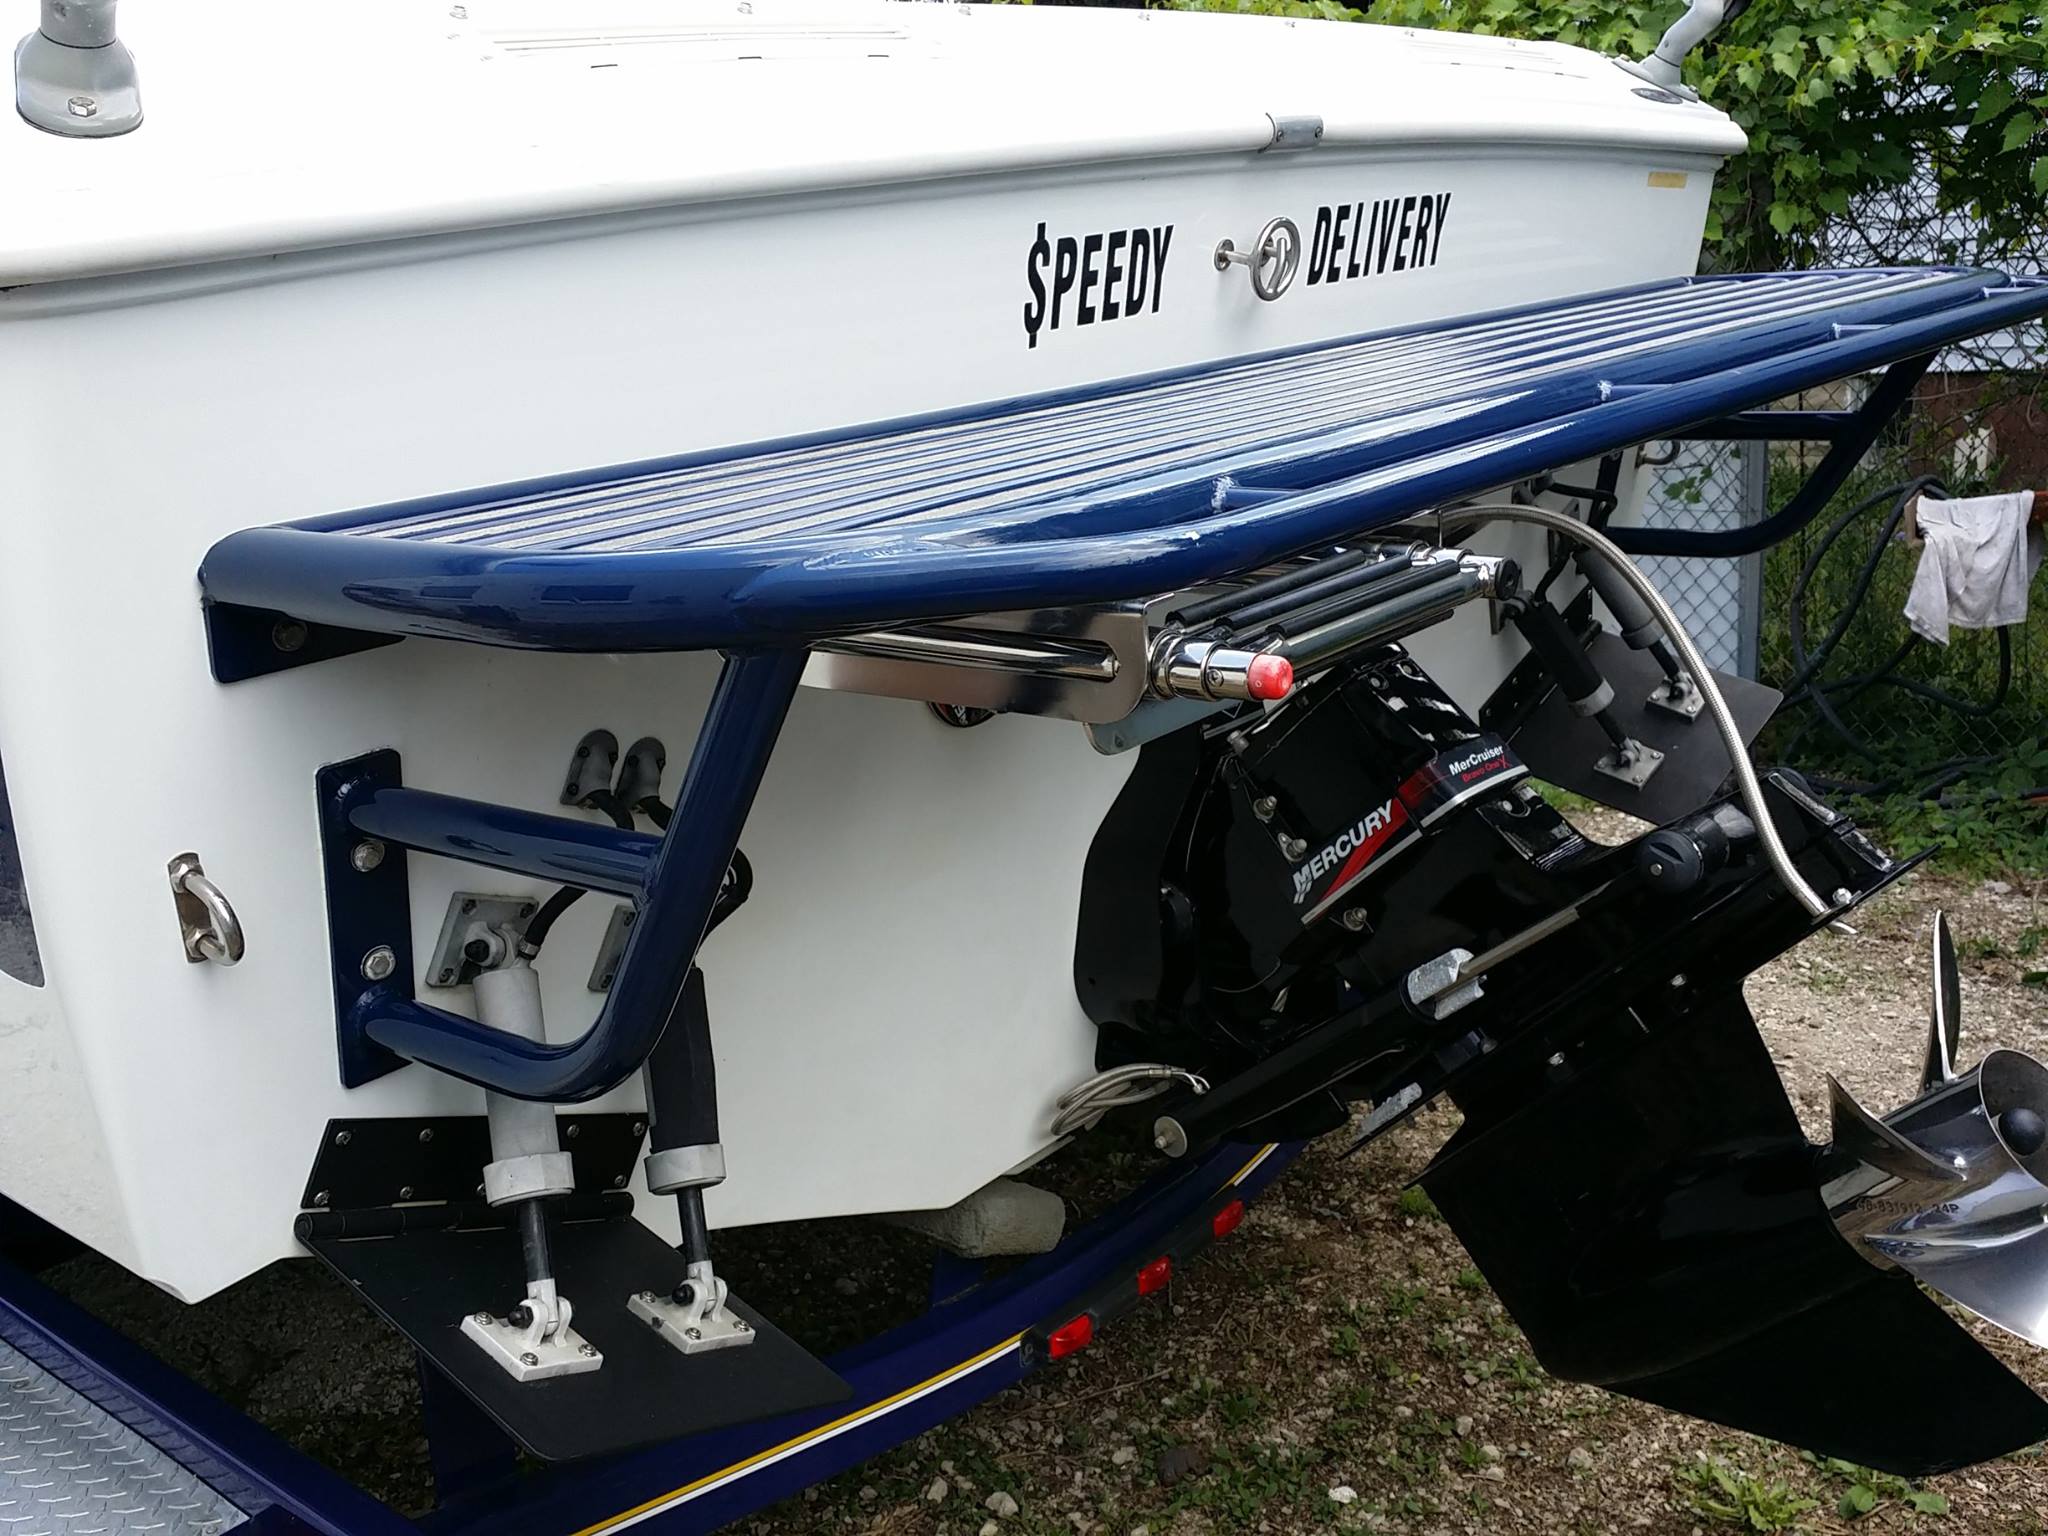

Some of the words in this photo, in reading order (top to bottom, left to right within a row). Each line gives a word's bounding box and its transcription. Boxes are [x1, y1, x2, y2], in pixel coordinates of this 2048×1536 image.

[1306, 193, 1452, 286] DELIVERY
[1448, 745, 1504, 776] MerCruiser
[1292, 799, 1393, 904] MERCURY
